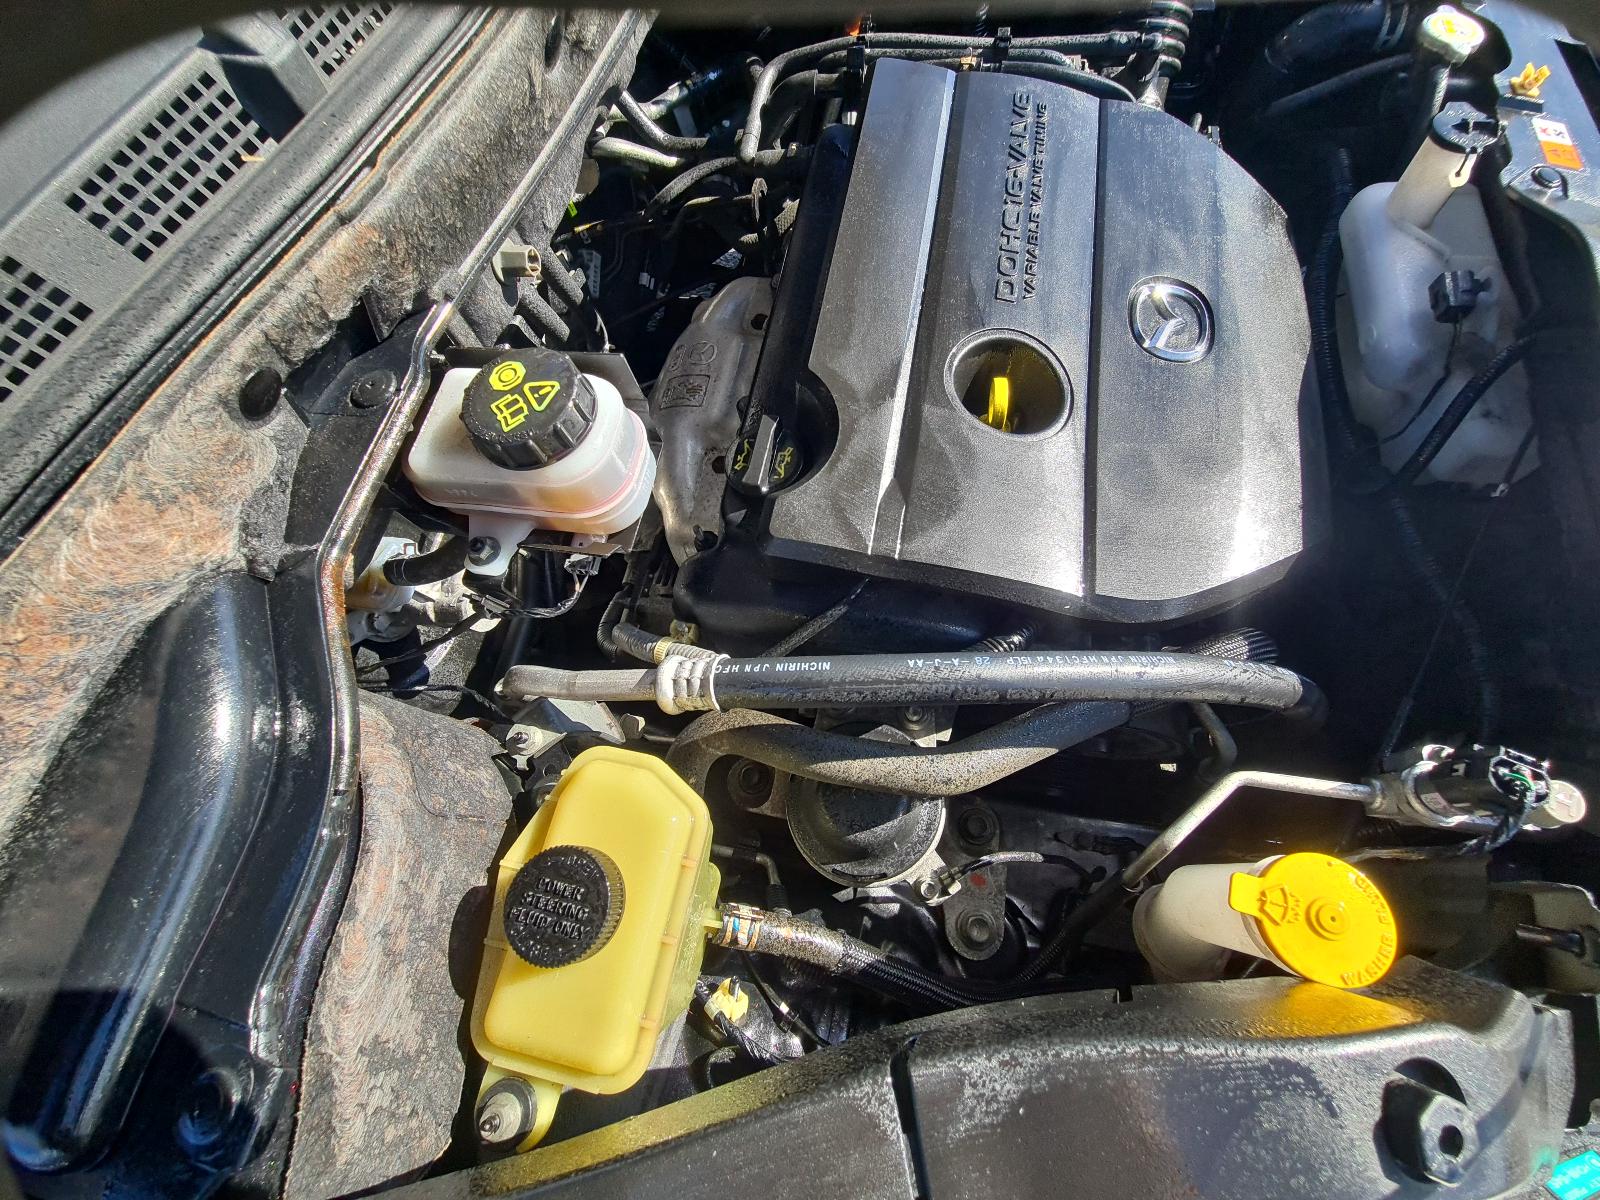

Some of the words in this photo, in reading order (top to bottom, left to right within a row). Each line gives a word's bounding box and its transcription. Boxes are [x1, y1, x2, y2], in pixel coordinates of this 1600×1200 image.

[1032, 100, 1049, 157] TIMING
[1029, 155, 1045, 209] VALVE
[995, 207, 1023, 304] DOHC
[1023, 209, 1042, 300] VARIABLE
[743, 662, 771, 673] JPN
[775, 661, 831, 672] NICHIRIN
[974, 655, 991, 665] 28
[536, 877, 585, 901] POWER
[520, 892, 590, 920] STEERING
[552, 921, 591, 940] ONLY
[1340, 934, 1394, 987] WASHER
